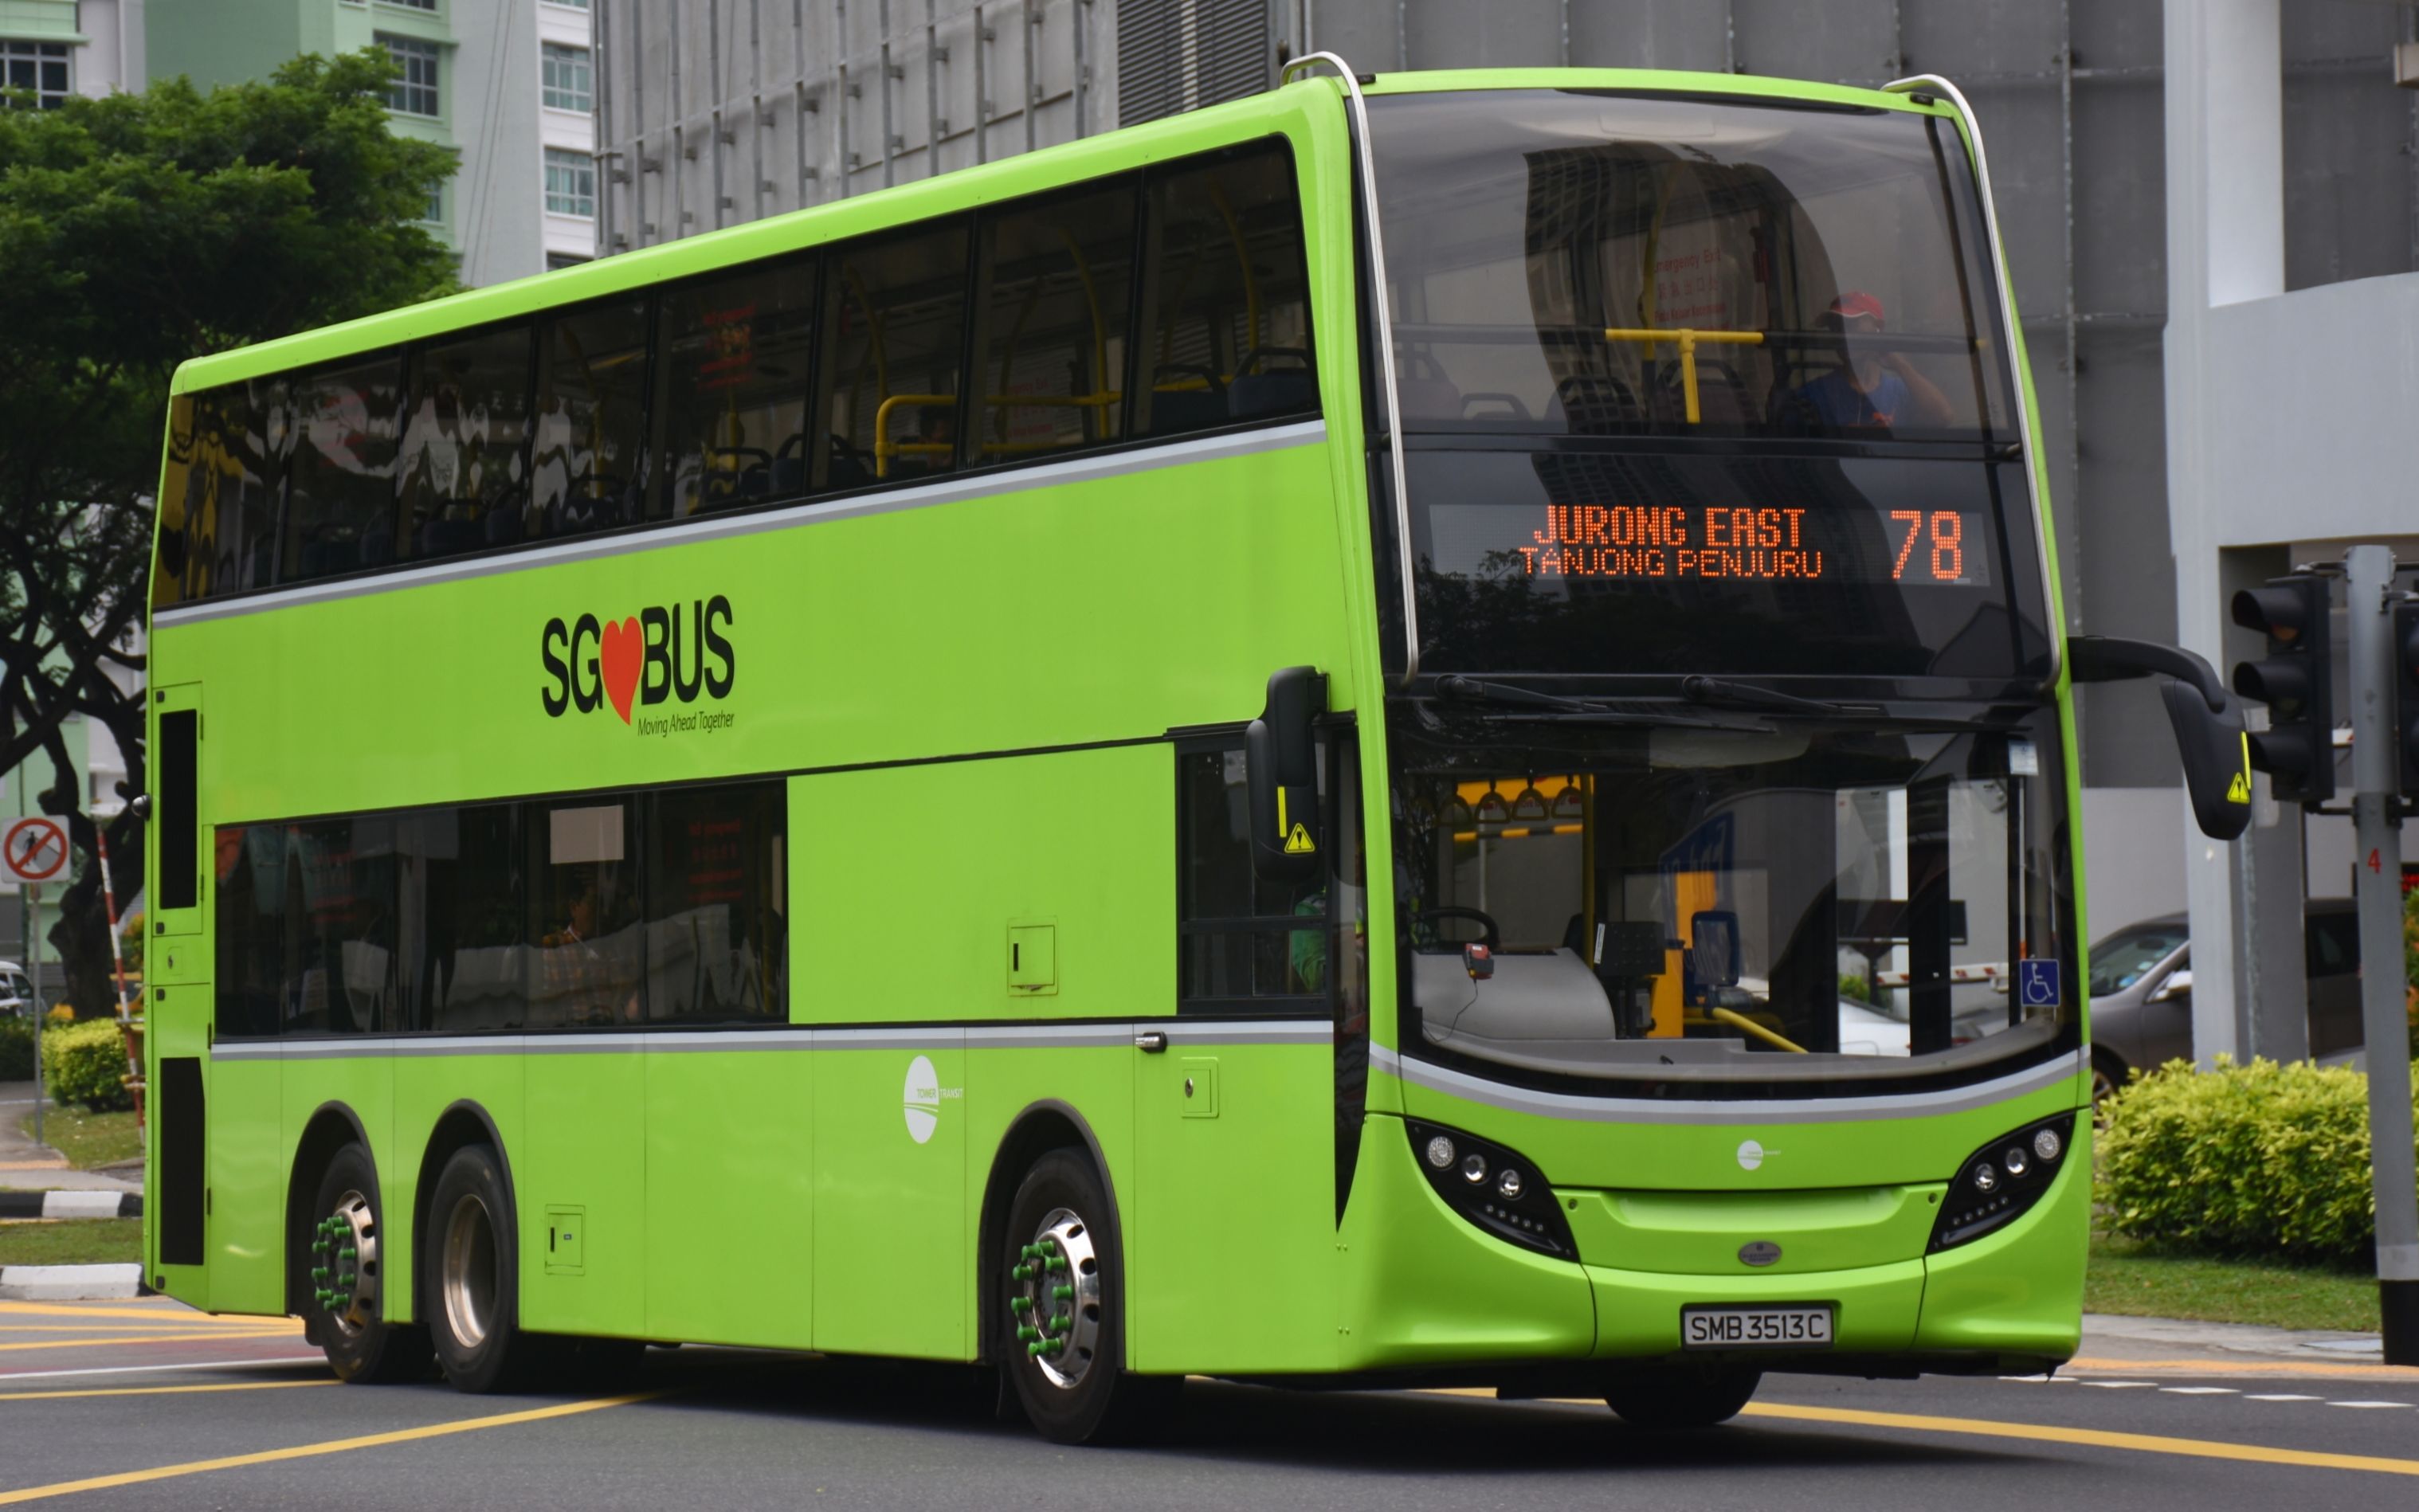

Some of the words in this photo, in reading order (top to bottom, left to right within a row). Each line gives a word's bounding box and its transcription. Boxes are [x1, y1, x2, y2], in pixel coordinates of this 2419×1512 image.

[1653, 254, 1700, 273] mergency
[1534, 505, 1686, 545] JURONG
[1706, 507, 1805, 547] EAST
[1891, 510, 1962, 580] 78
[1519, 547, 1665, 576] TANJONG
[1678, 550, 1821, 578] PENJURU
[637, 716, 668, 738] Moving
[669, 711, 697, 732] Ahead
[699, 710, 735, 734] Together
[2367, 848, 2382, 874] 4
